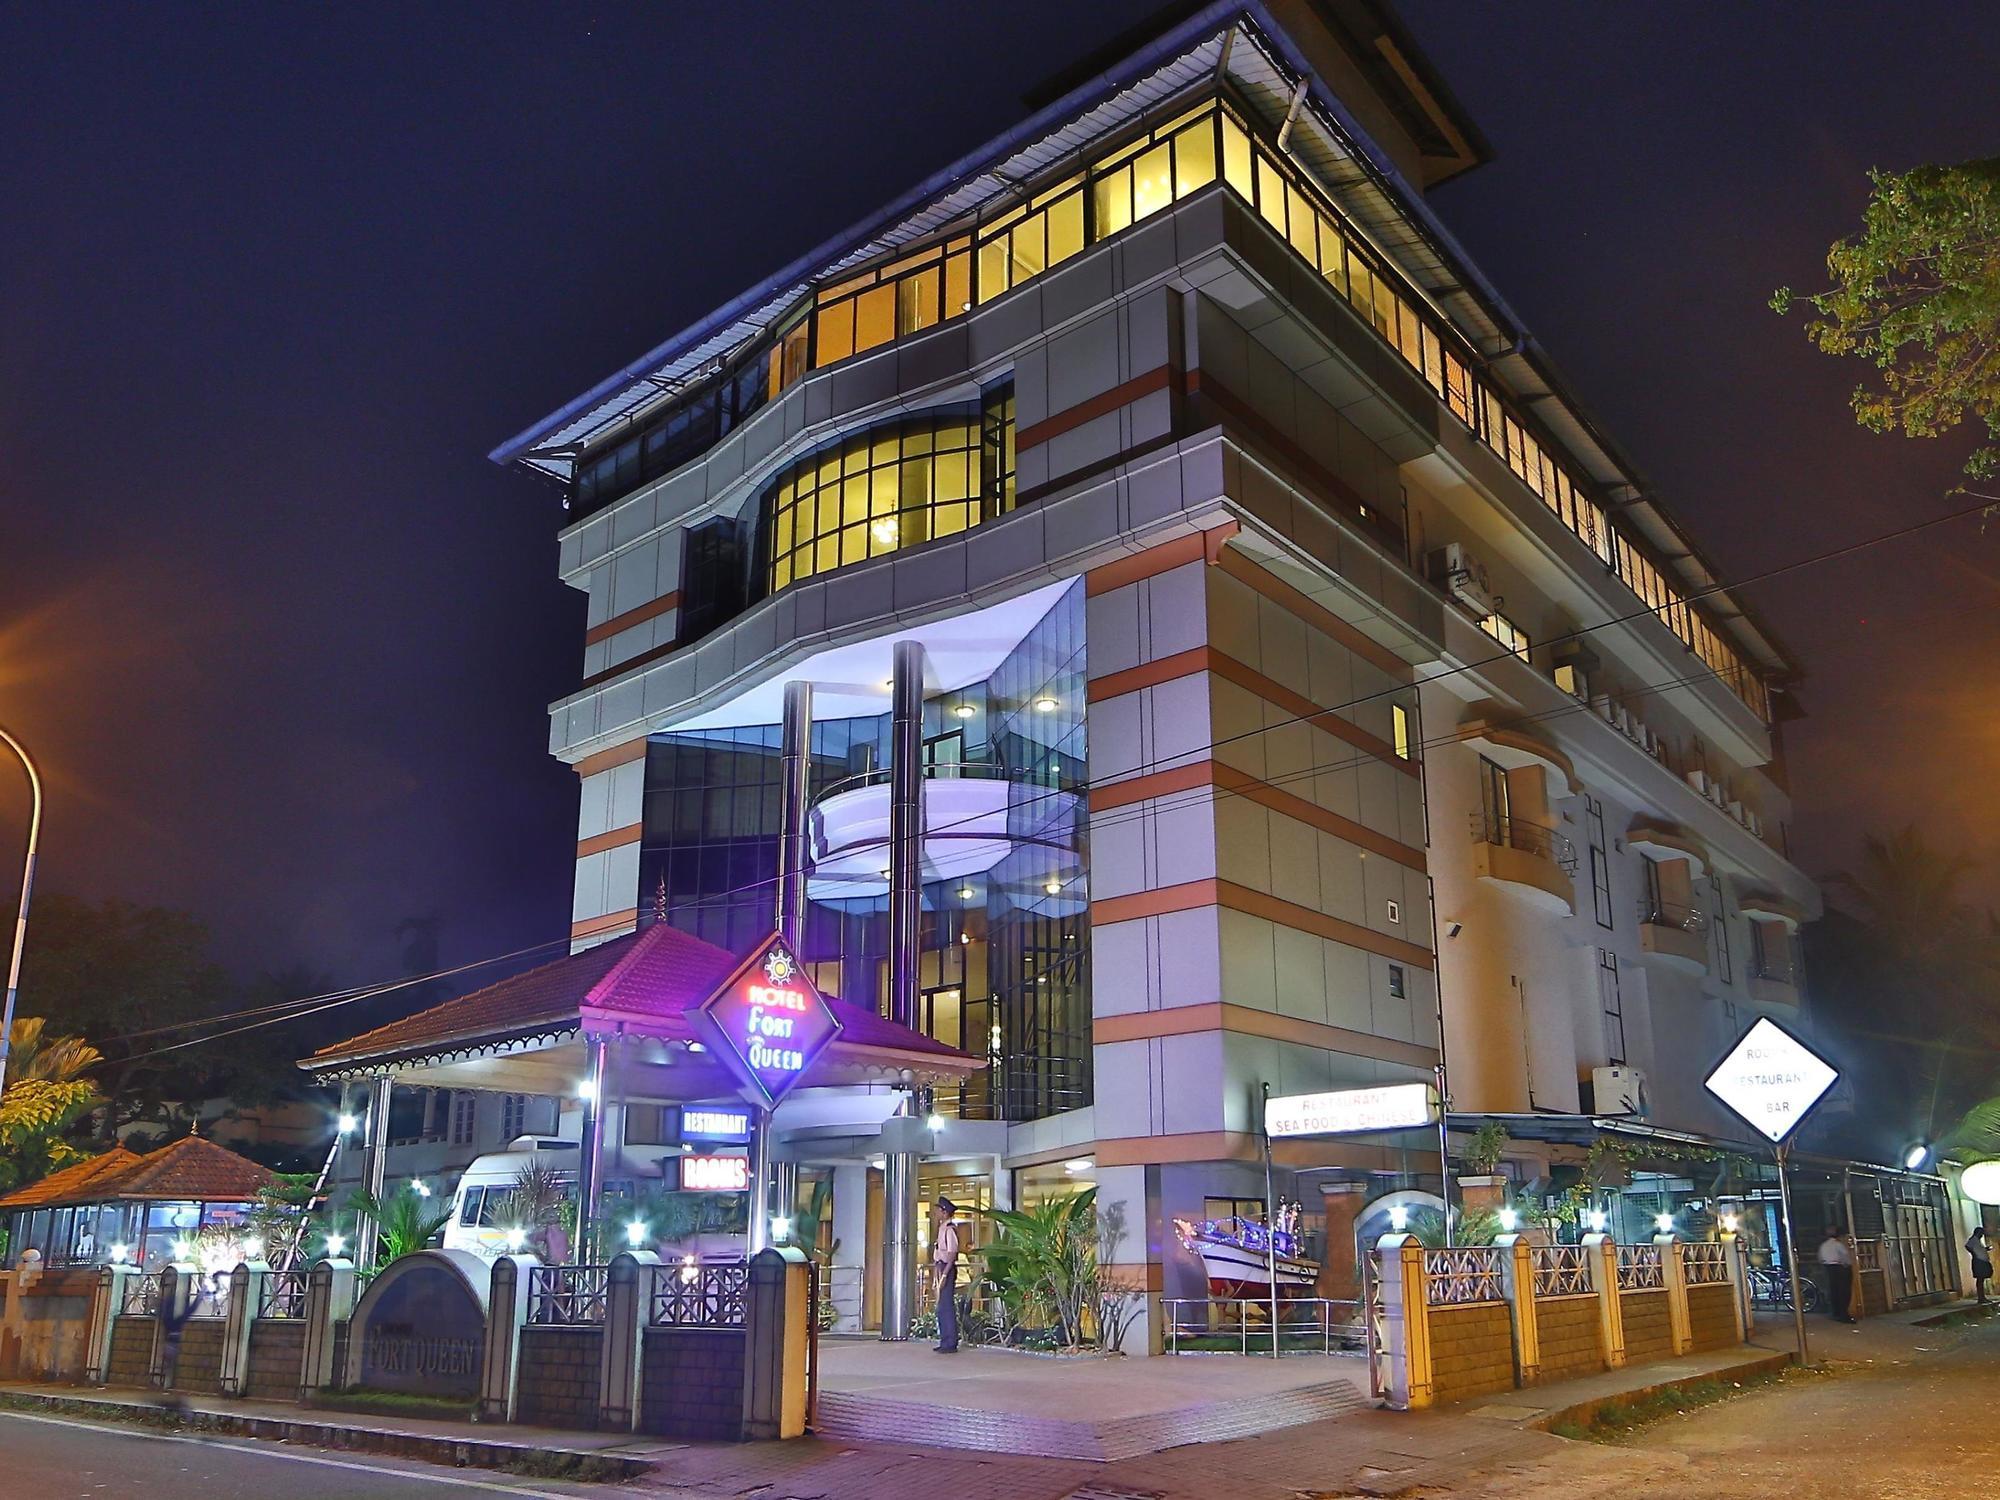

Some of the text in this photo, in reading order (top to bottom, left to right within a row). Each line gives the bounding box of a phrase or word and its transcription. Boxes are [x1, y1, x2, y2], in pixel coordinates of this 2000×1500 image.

[749, 985, 806, 1010] HOTEL
[749, 1007, 794, 1037] FORT
[749, 1045, 803, 1070] QUEEN
[1767, 1101, 1791, 1114] BAR
[684, 1112, 747, 1134] RESTAURANT
[1276, 1119, 1300, 1133] SEA
[1304, 1117, 1338, 1130] FOOD
[684, 1159, 746, 1188] ROOMS
[368, 1325, 474, 1376] FORT QUEEN
